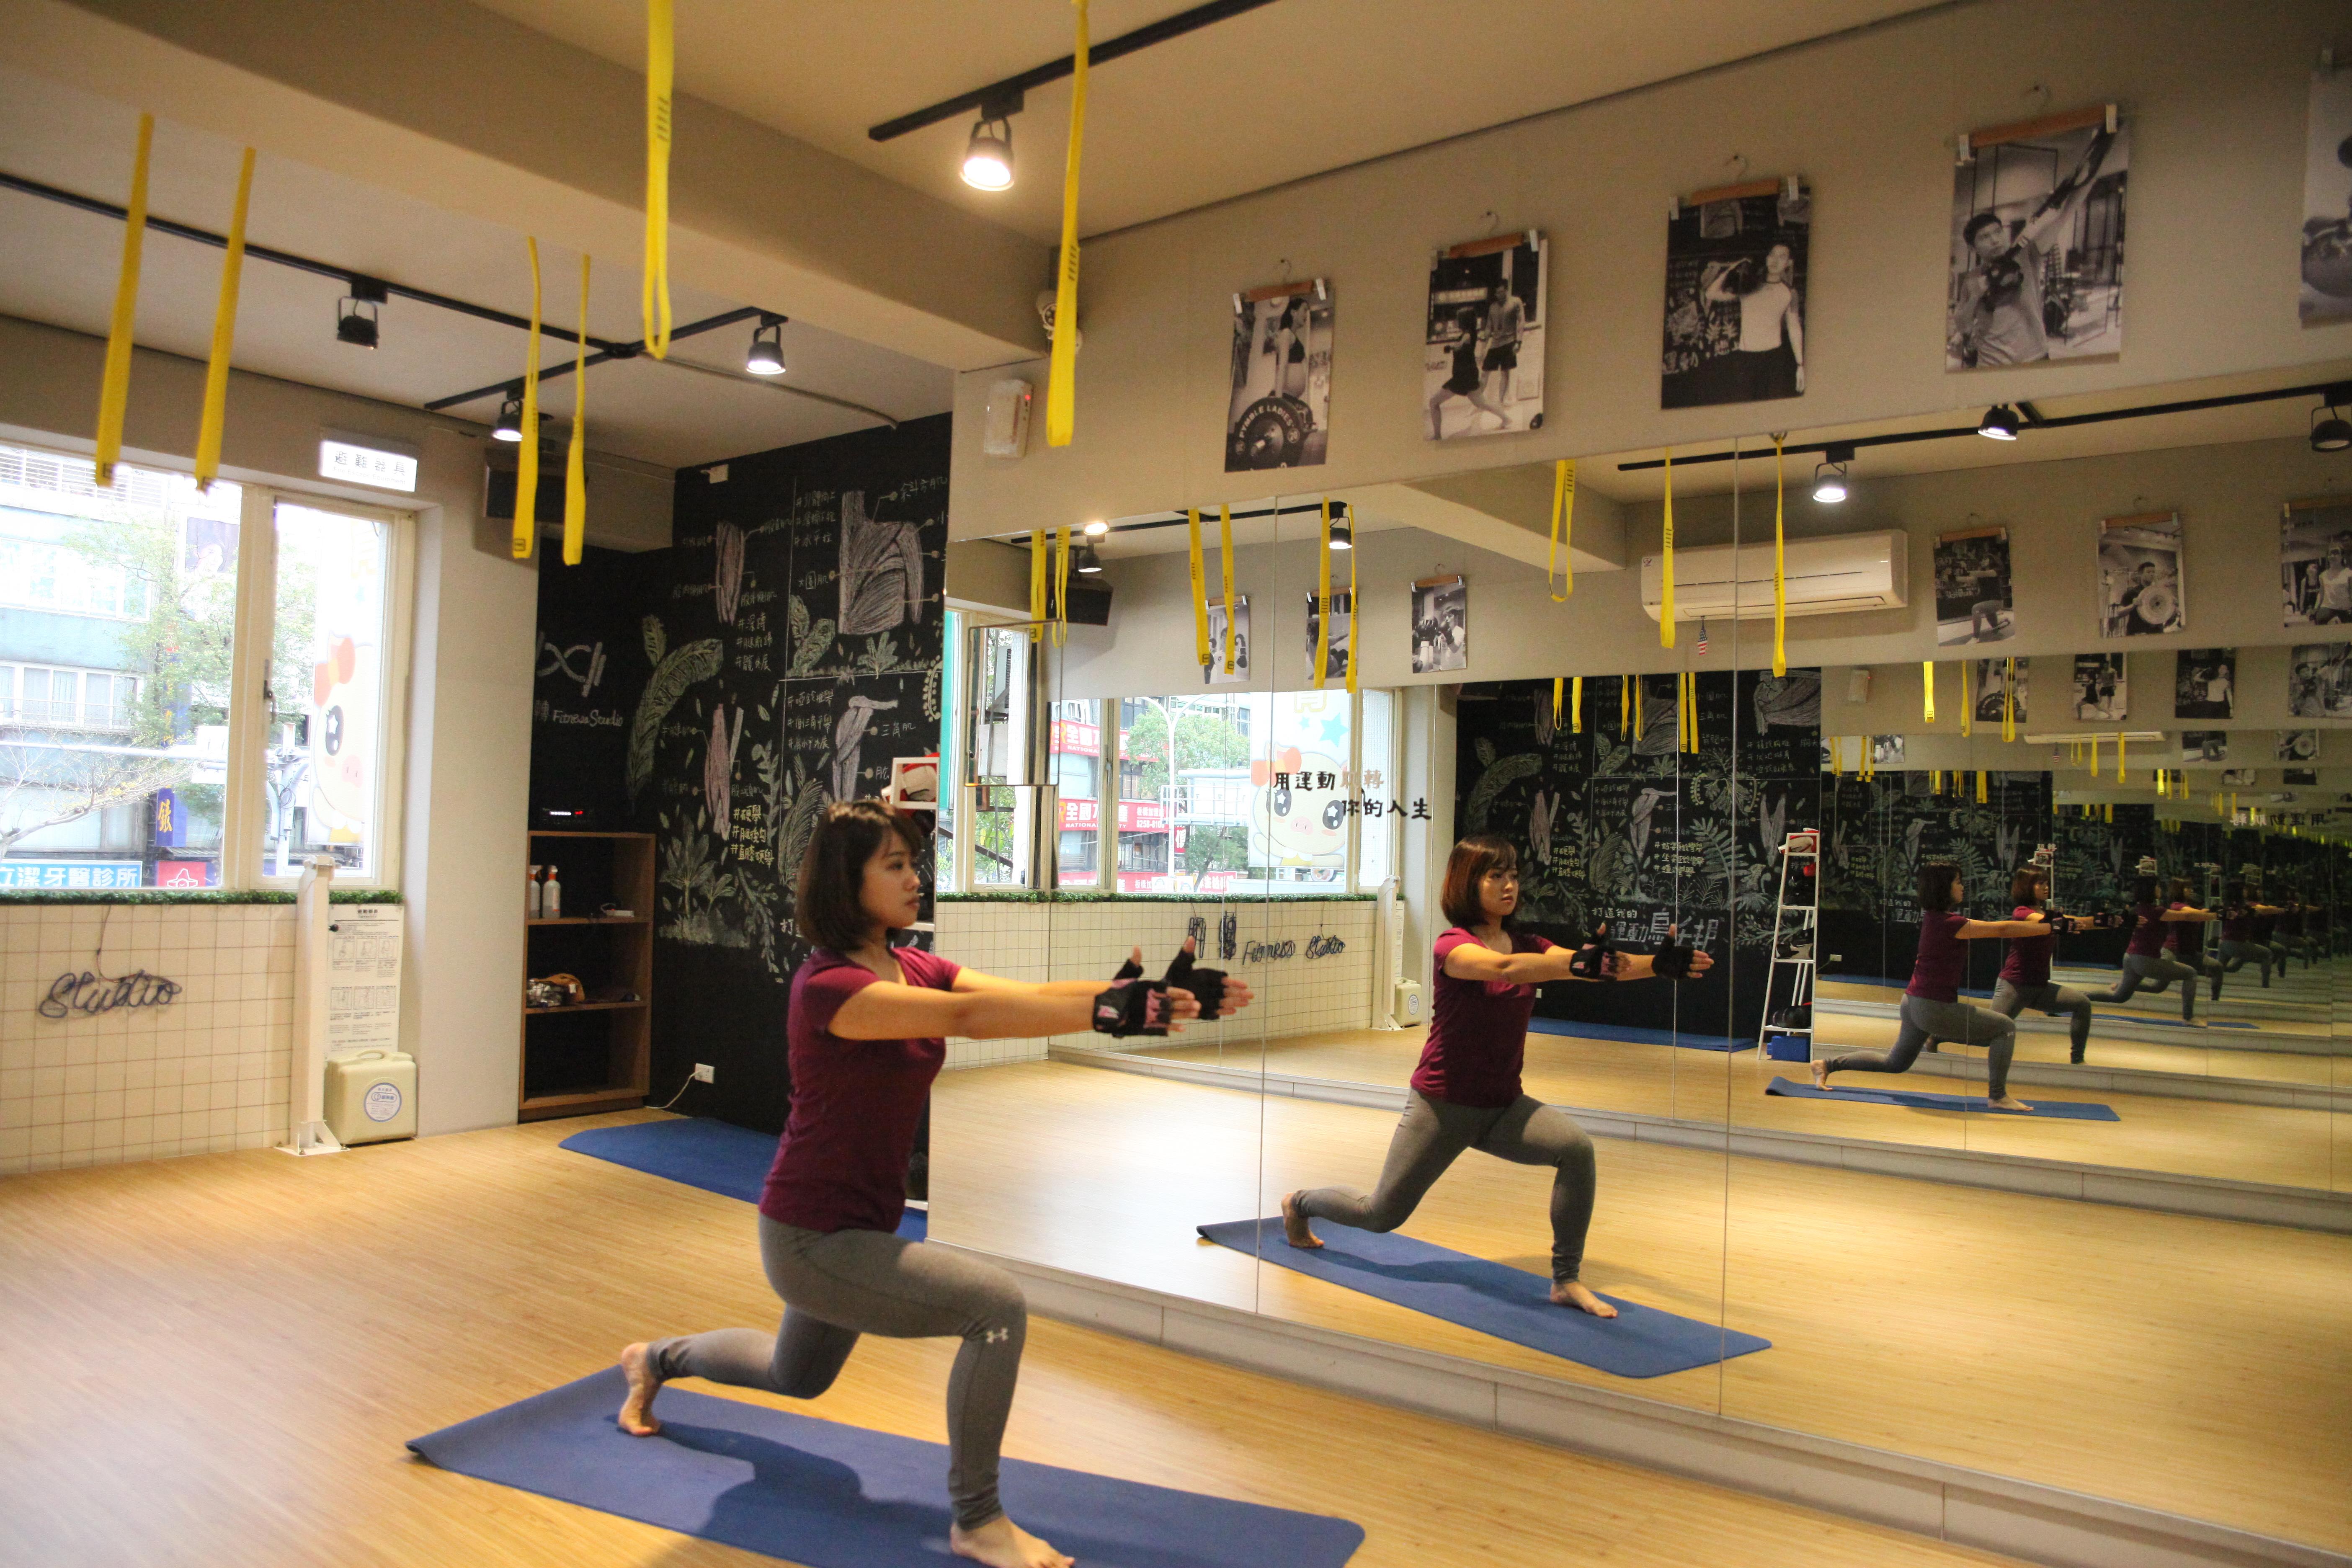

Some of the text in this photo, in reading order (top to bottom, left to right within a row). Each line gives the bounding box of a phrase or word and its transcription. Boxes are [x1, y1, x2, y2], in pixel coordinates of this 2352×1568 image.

[335, 451, 405, 476] 避難器具
[882, 721, 917, 738] 三角肌
[1068, 745, 1100, 753] NATIONA
[1341, 797, 1432, 820] 你的人生
[0, 866, 138, 887] 立潔牙醫診所
[1592, 907, 1637, 919] 打造我的
[39, 969, 183, 1018] Studio
